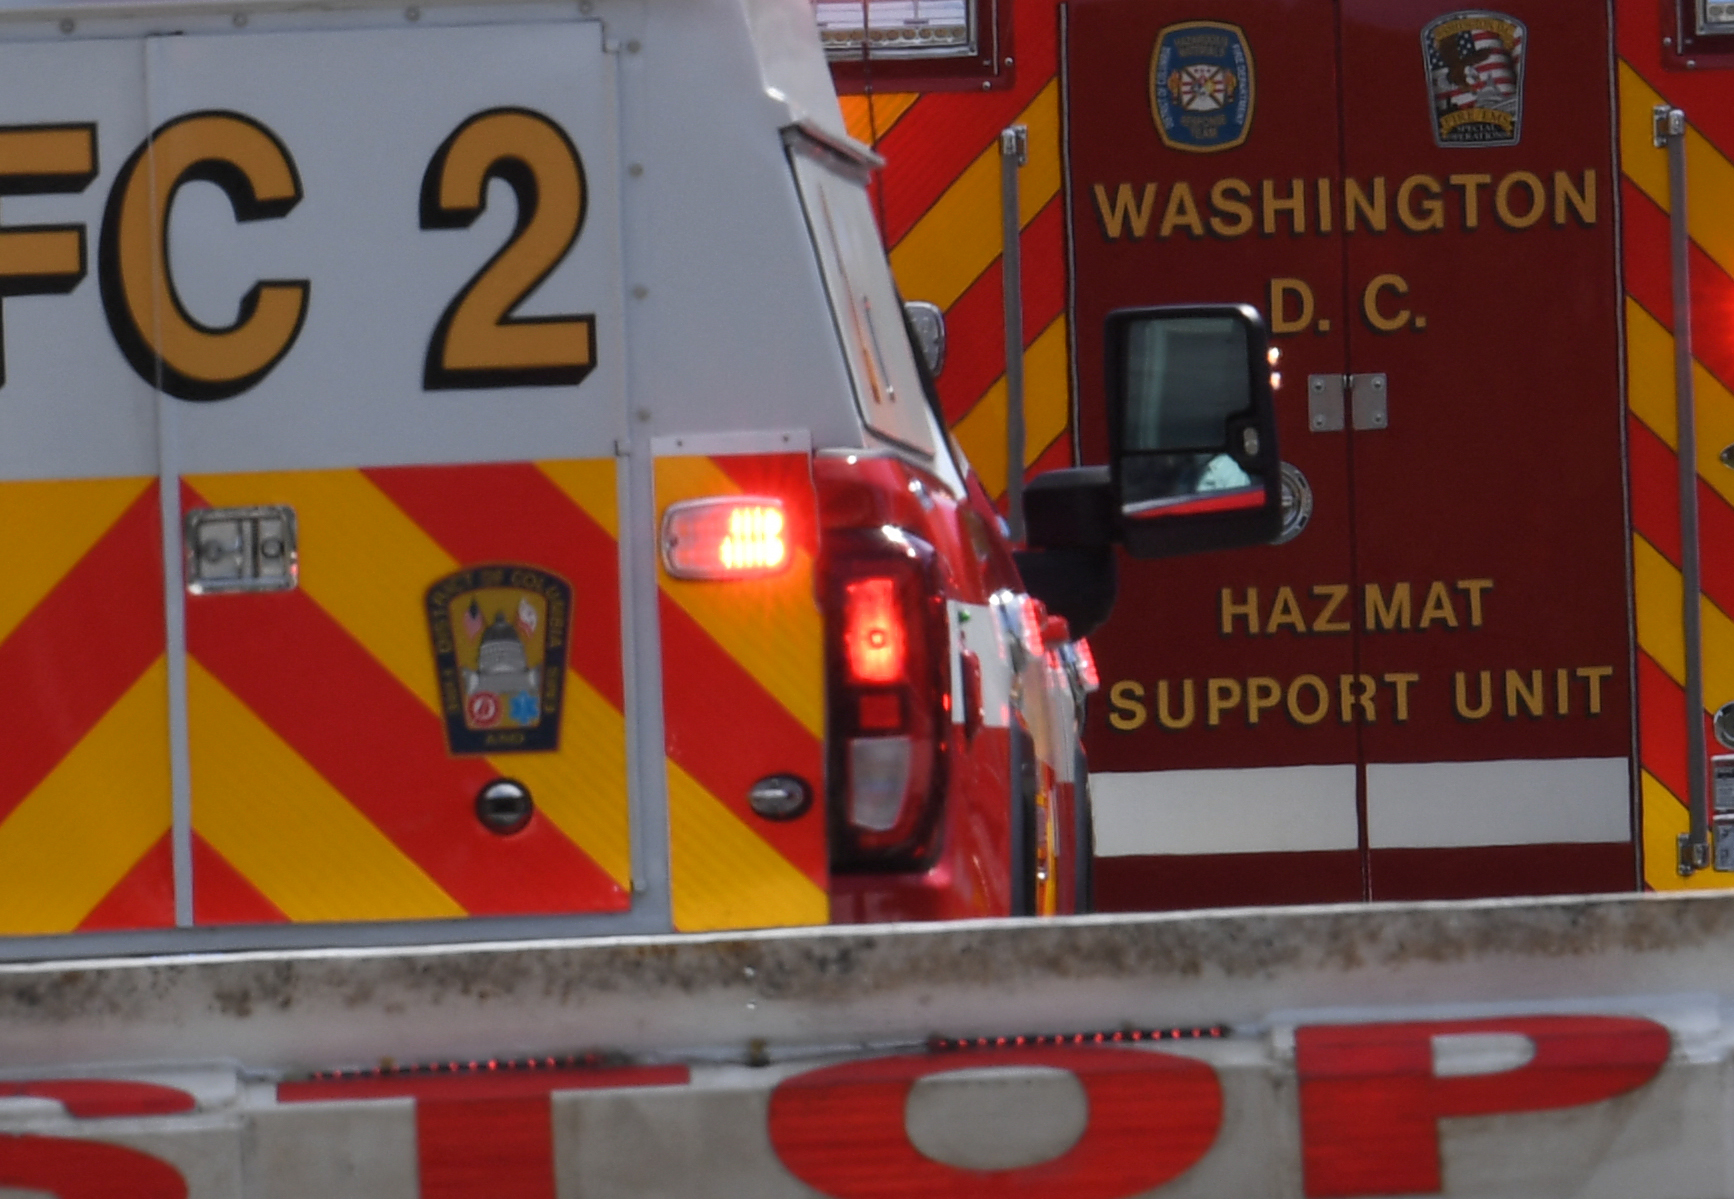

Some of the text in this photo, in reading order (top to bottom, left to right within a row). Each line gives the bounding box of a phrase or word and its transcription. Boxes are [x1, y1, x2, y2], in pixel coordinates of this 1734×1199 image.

[1094, 169, 1598, 239] WASHINGTON
[419, 105, 598, 390] 2
[1270, 274, 1427, 334] D. C.
[1109, 667, 1613, 731] SUPPORT UNIT
